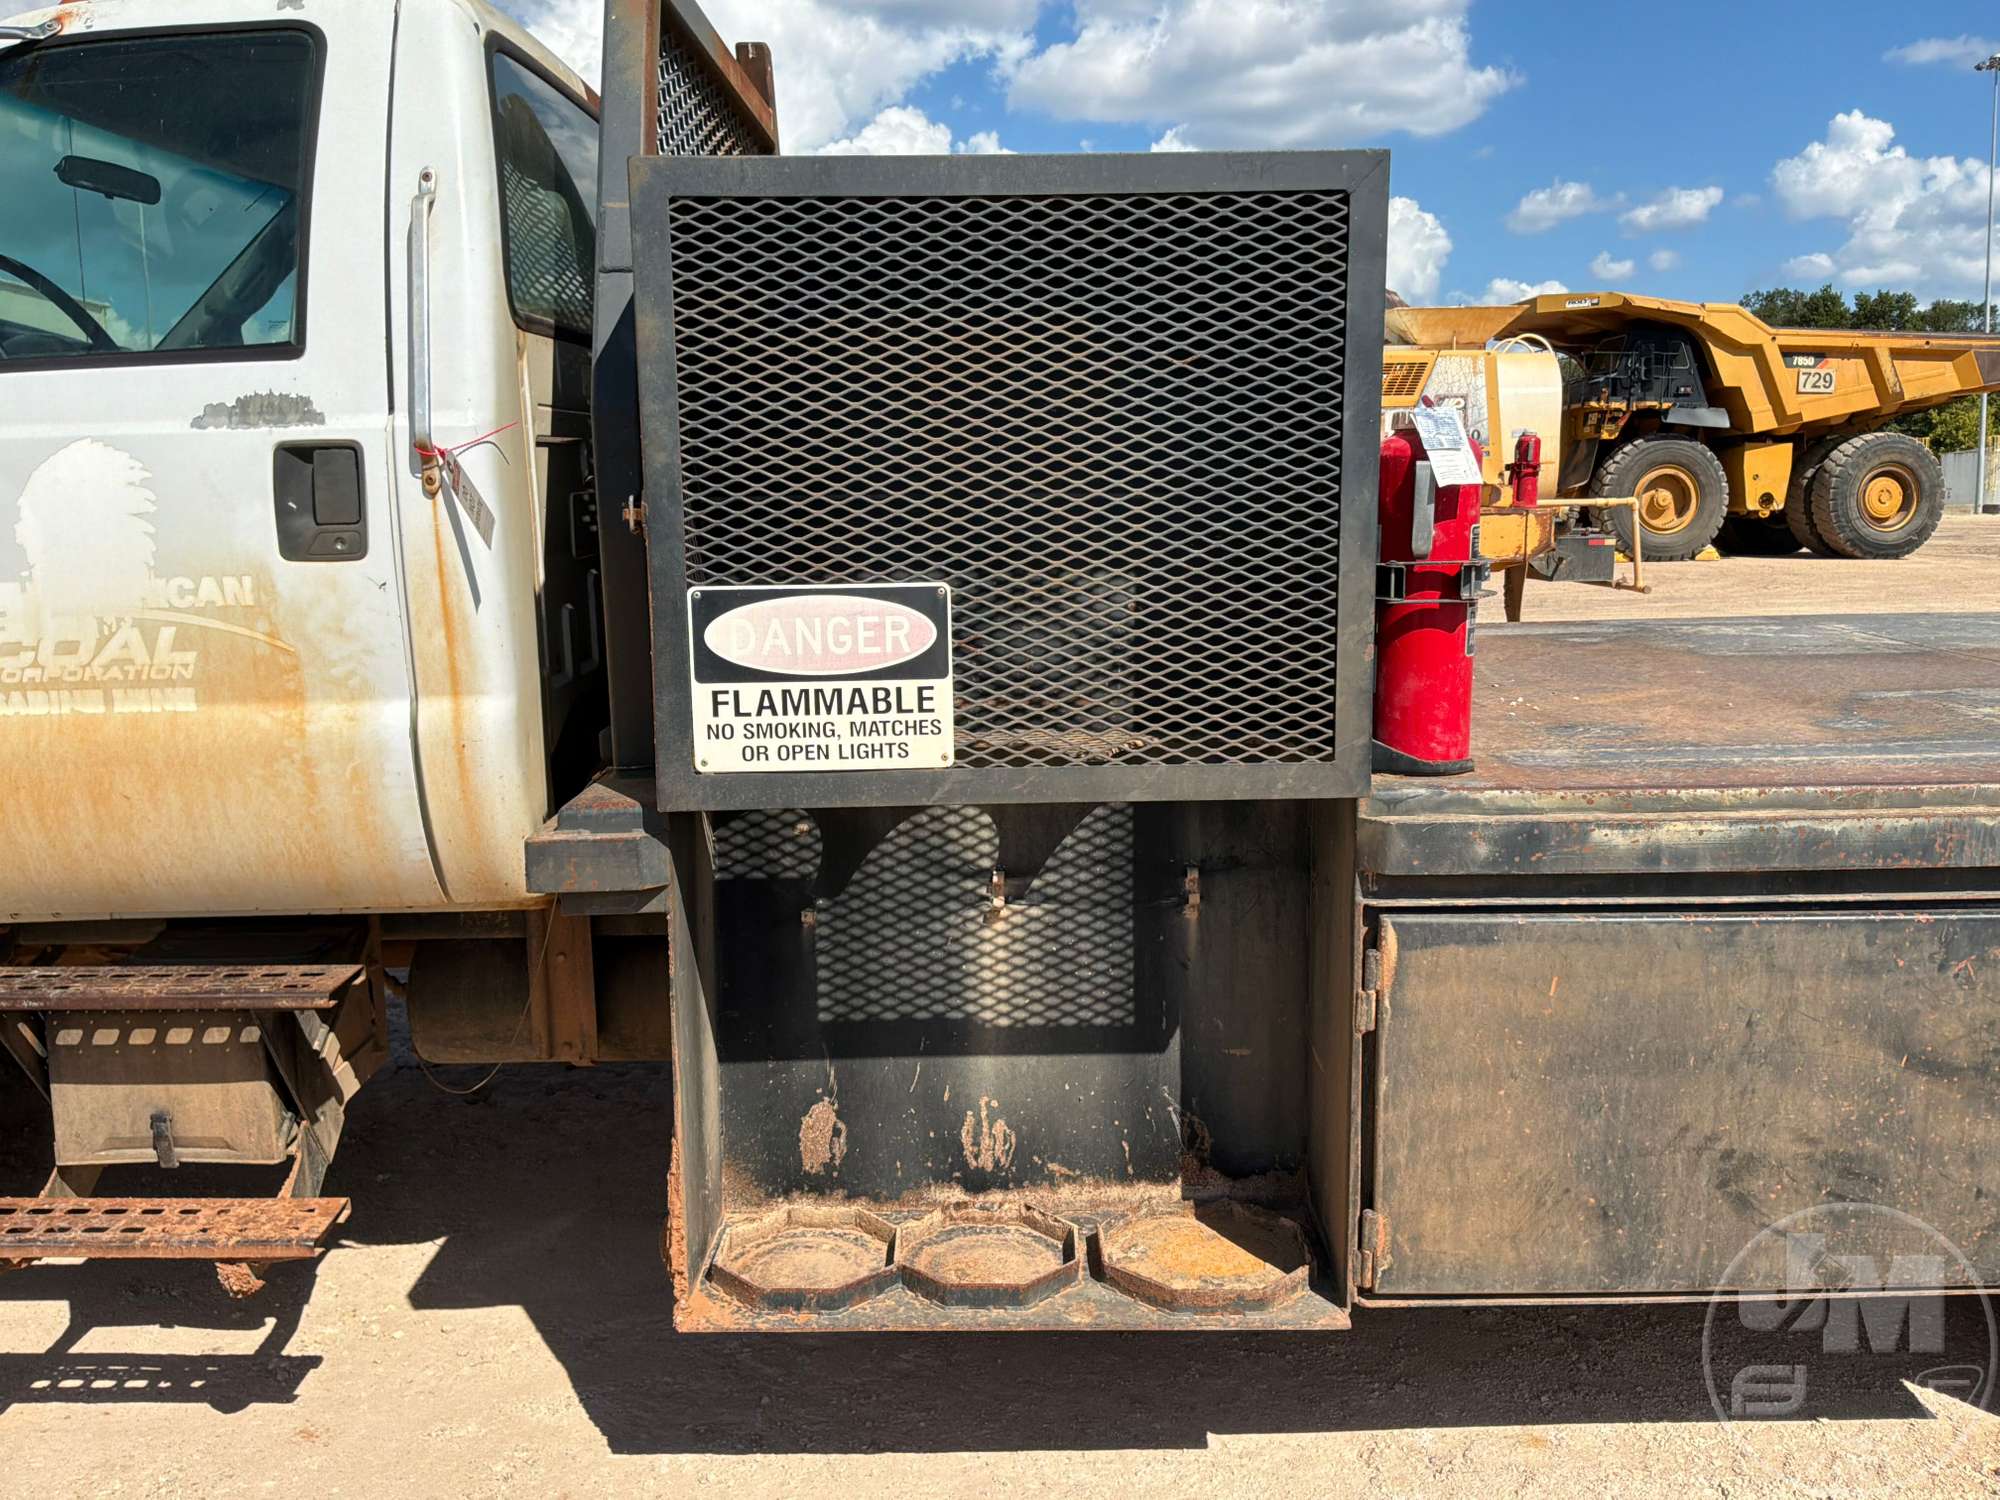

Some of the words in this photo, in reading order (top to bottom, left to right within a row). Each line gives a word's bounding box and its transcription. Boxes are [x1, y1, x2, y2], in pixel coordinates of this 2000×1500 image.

[1801, 371, 1833, 389] 729
[727, 614, 912, 657] DANGER
[0, 663, 195, 683] ORPORATION
[711, 685, 936, 718] FLAMMABLE
[706, 723, 735, 740] NO
[743, 720, 842, 741] SMOKING,
[849, 718, 943, 737] MATCHES
[741, 745, 770, 762] OR
[777, 743, 831, 761] OPEN
[838, 742, 910, 760] LIGHTS
